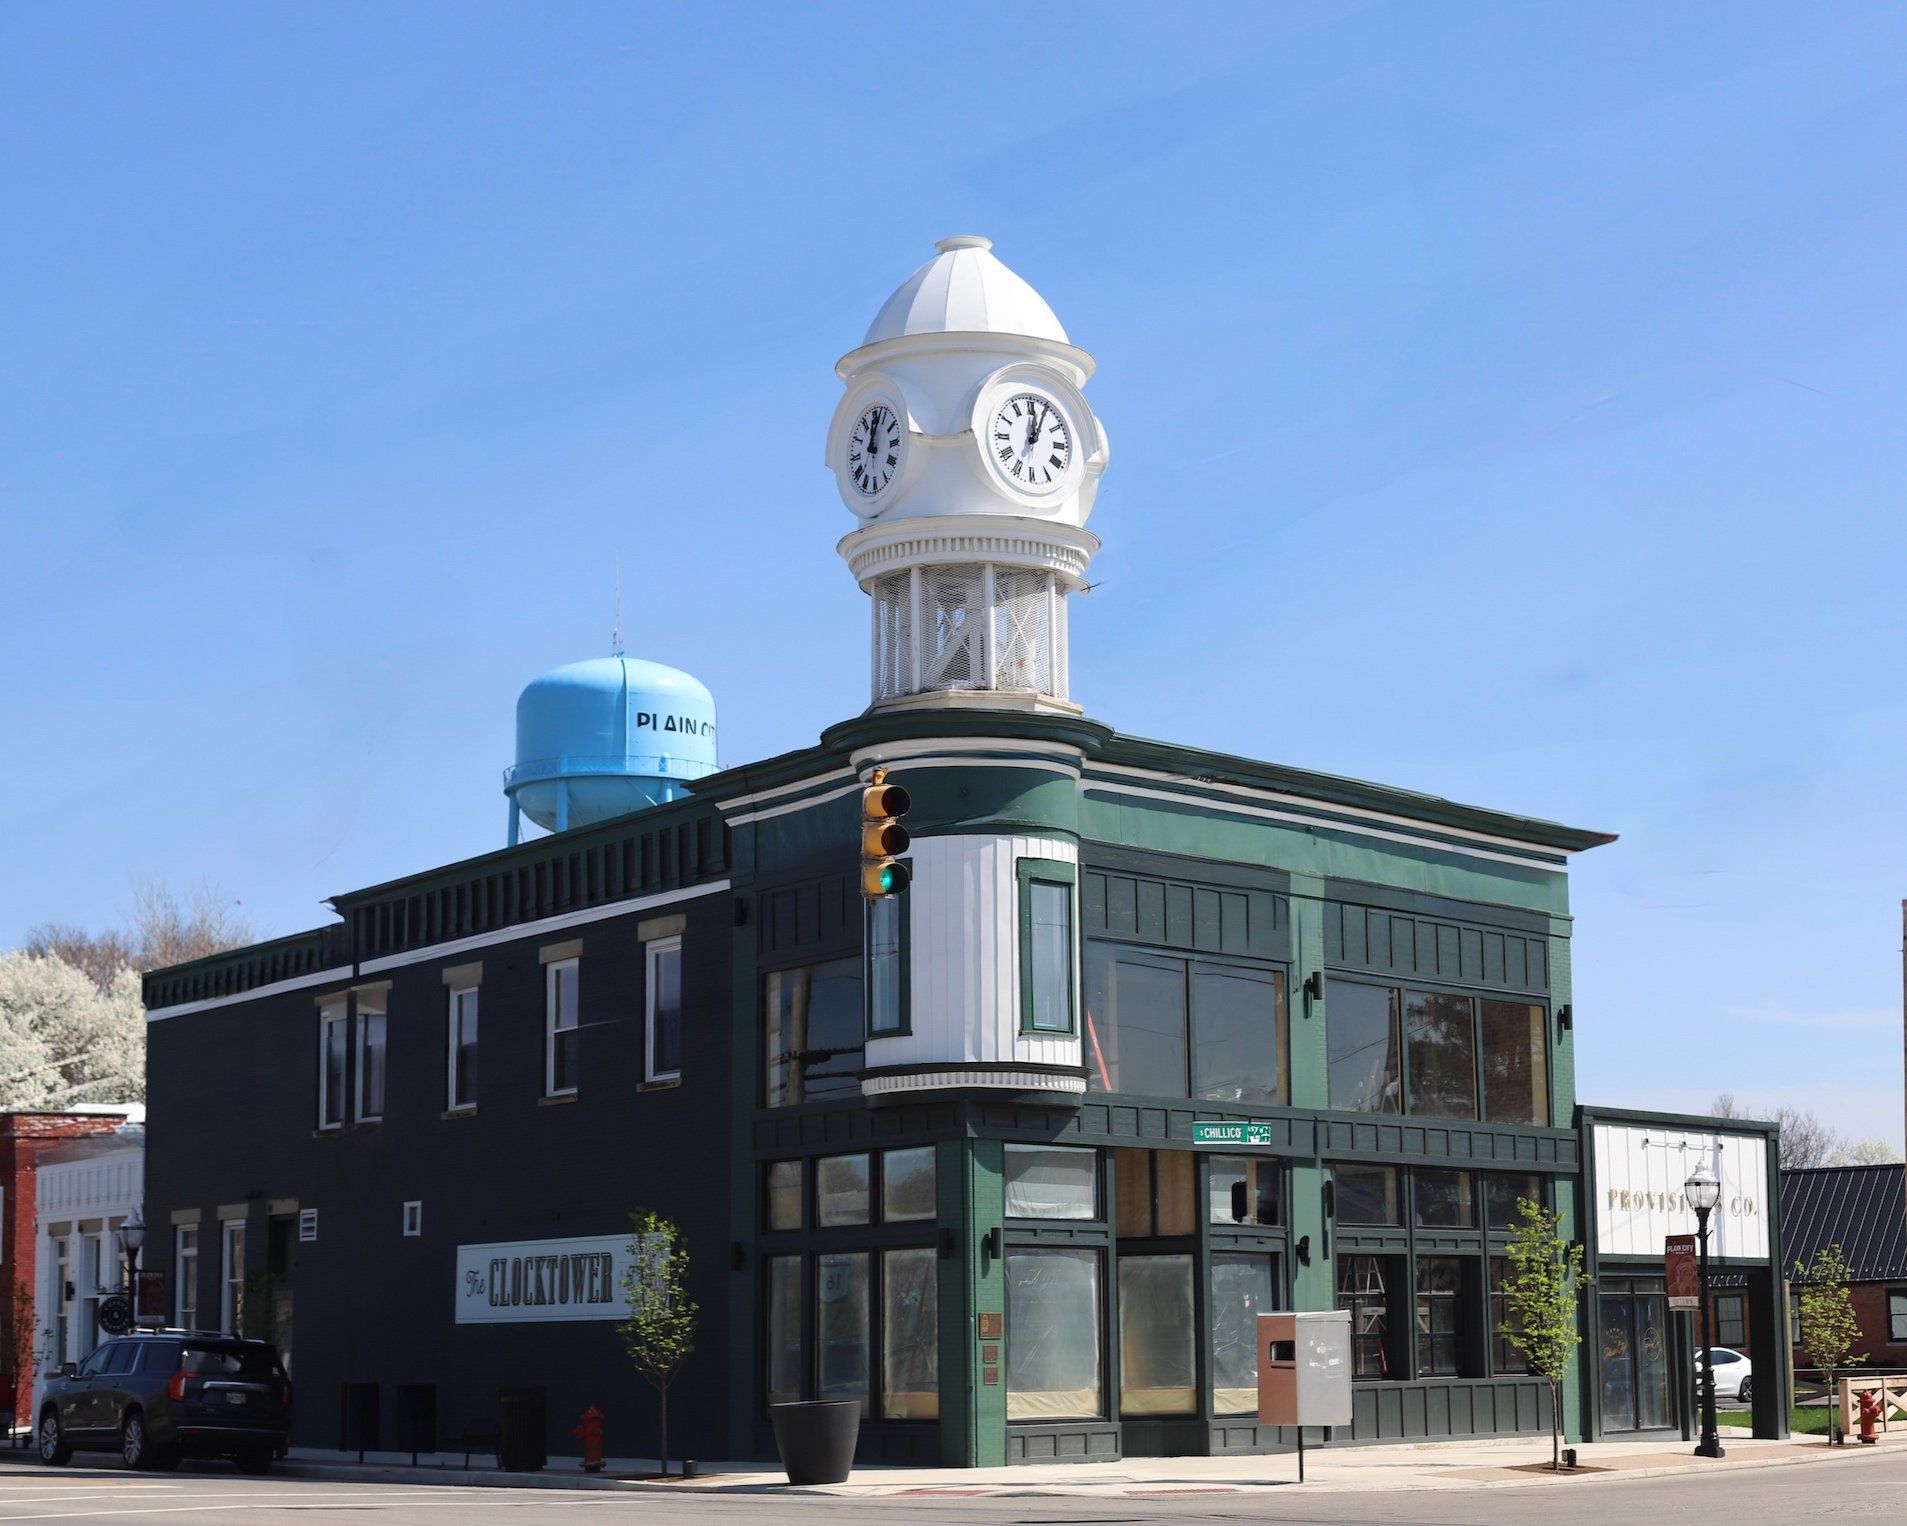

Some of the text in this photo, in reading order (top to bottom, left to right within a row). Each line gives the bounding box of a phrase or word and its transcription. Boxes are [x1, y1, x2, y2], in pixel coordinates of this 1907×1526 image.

[1204, 1127, 1242, 1139] CHILLICO
[1607, 1188, 1758, 1218] PROVISIS CO.
[466, 1270, 487, 1298] The
[488, 1251, 614, 1307] CLOCKTOWER
